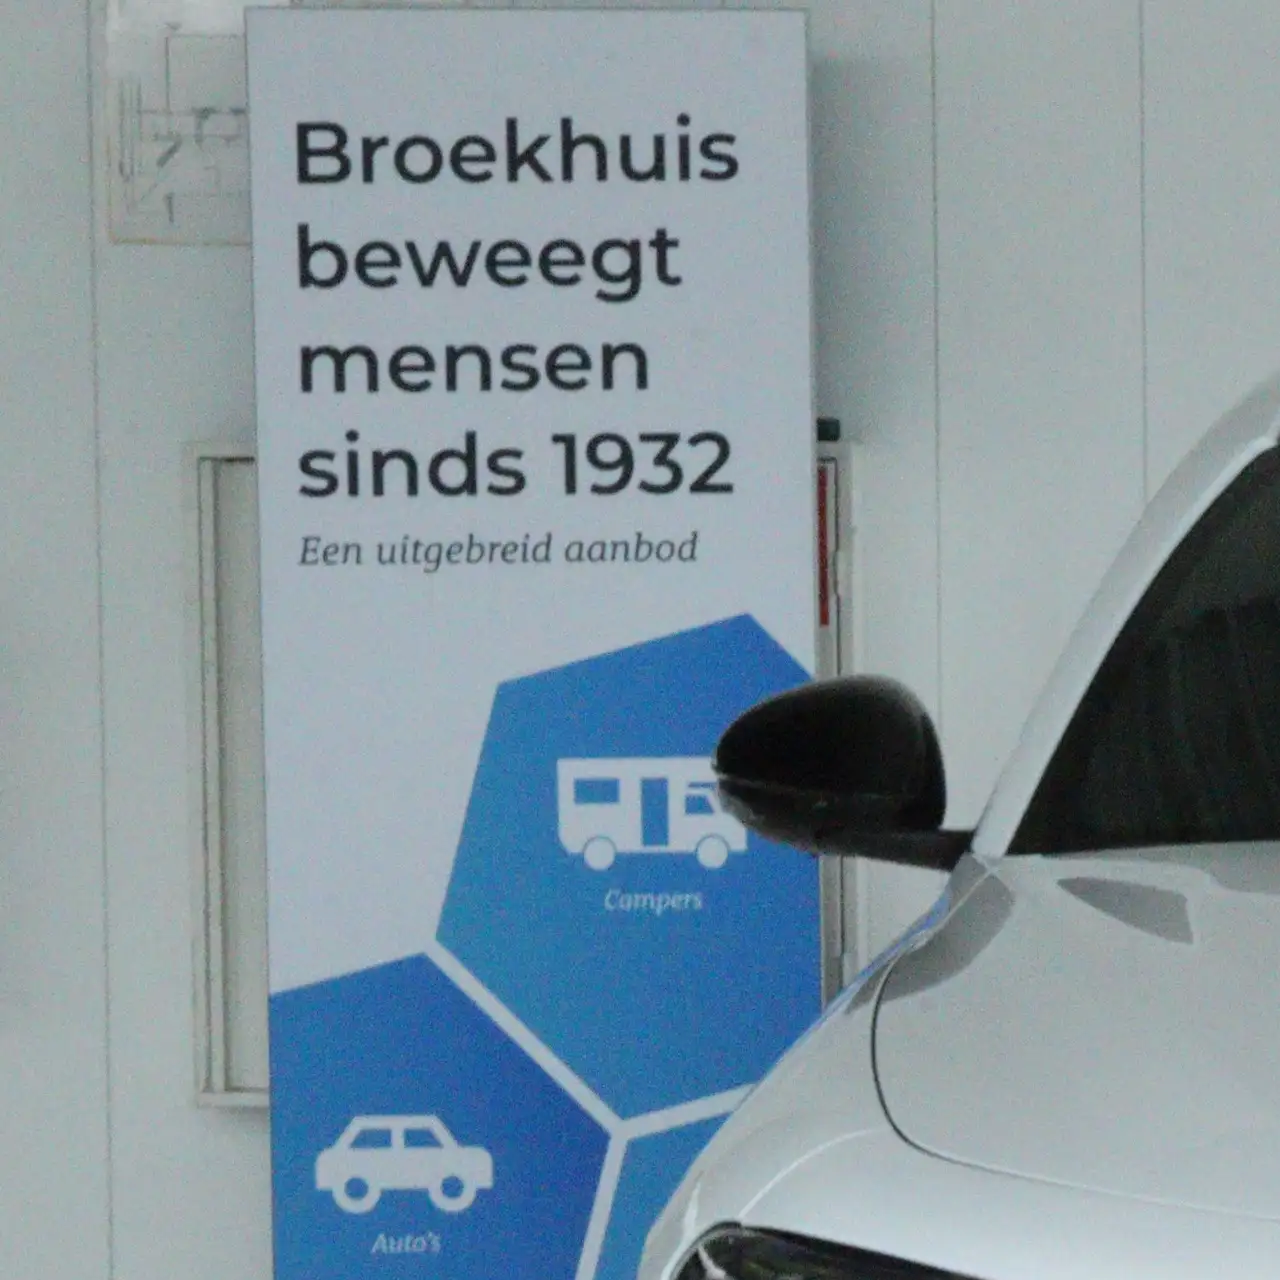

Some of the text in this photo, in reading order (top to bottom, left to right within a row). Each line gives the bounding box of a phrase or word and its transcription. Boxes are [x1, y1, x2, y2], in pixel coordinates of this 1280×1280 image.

[297, 112, 739, 185] Broekhuis
[298, 222, 682, 304] beweegt
[300, 342, 649, 393] mensen
[299, 429, 734, 497] sinds 1932
[298, 530, 699, 574] Een uitgebreid aanbod
[604, 887, 703, 916] Campers
[370, 1231, 441, 1255] Auto's
